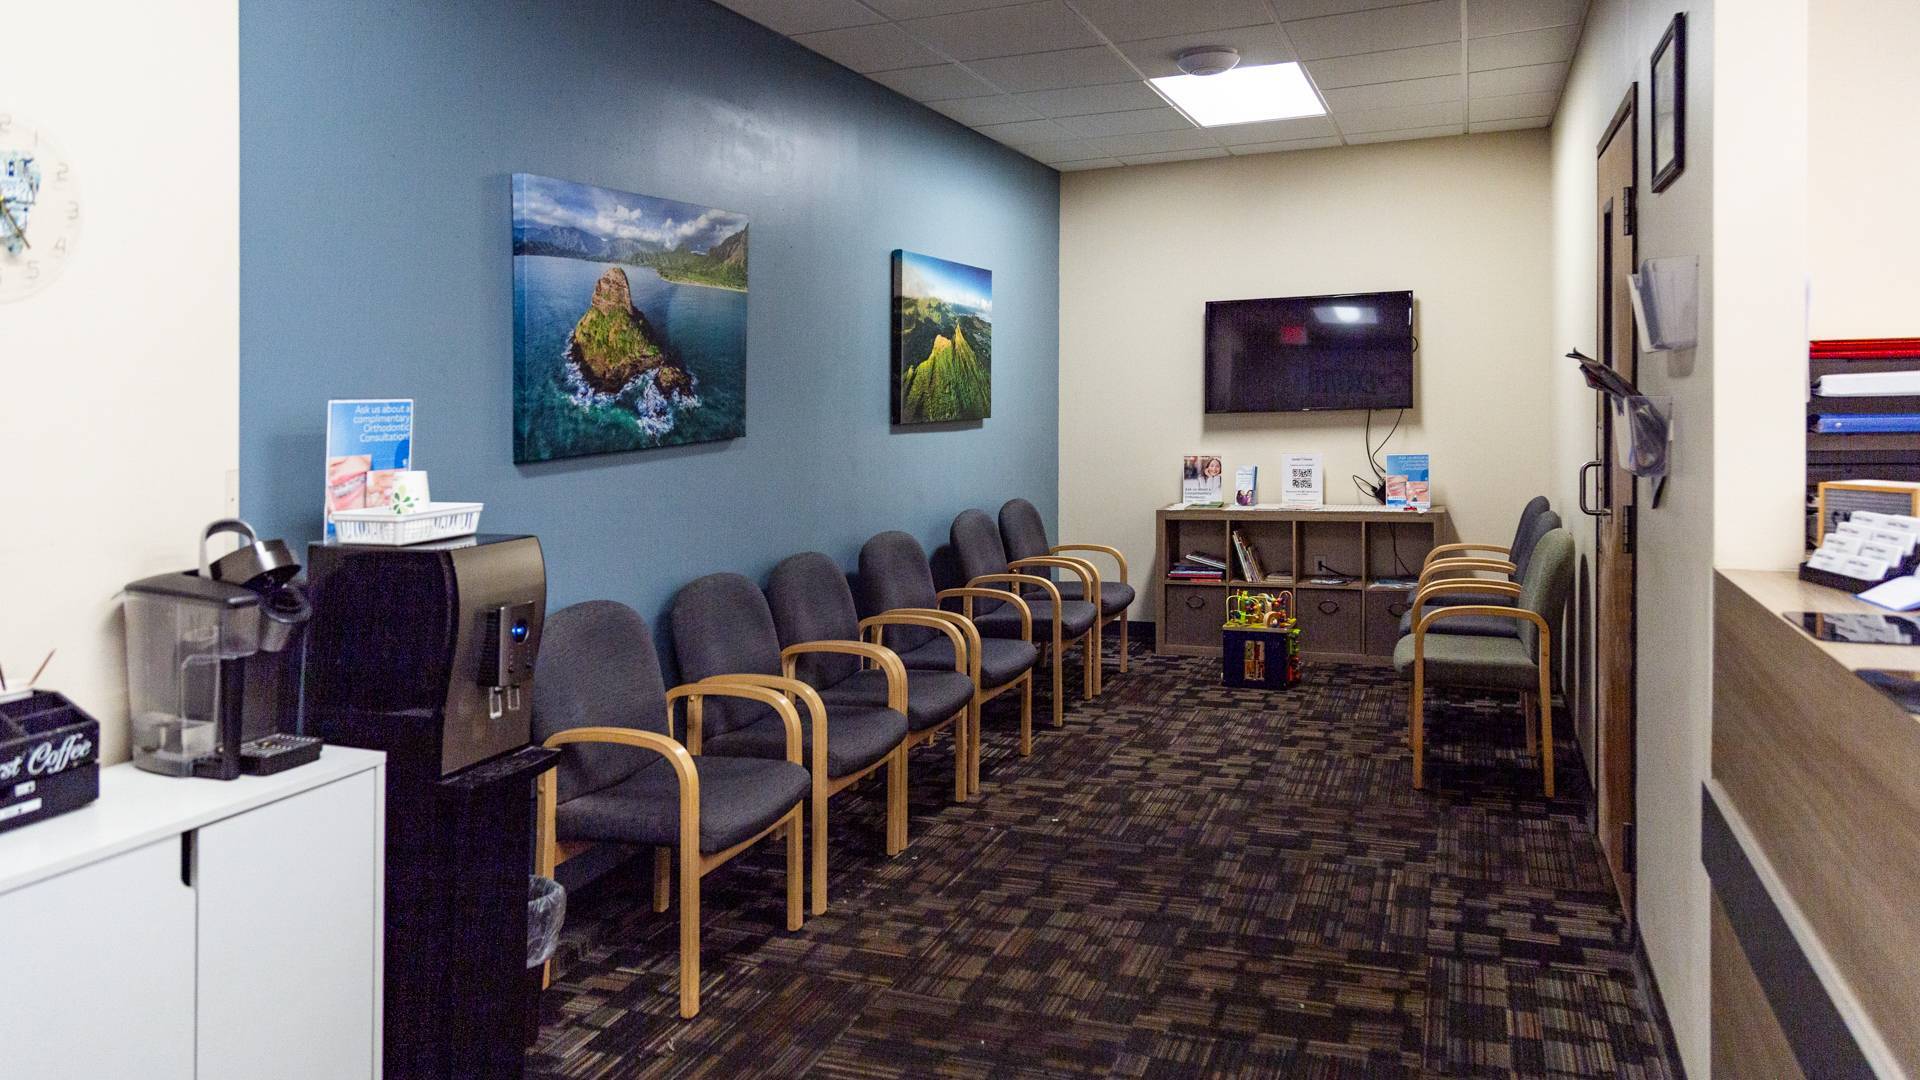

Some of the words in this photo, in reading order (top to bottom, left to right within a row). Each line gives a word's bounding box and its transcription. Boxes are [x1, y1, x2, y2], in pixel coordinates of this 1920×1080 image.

[355, 405, 370, 414] Ask
[382, 405, 405, 414] about
[353, 415, 410, 424] complimentary
[363, 424, 410, 433] Orthodontic
[0, 755, 23, 780] st
[27, 733, 92, 775] Coffee
